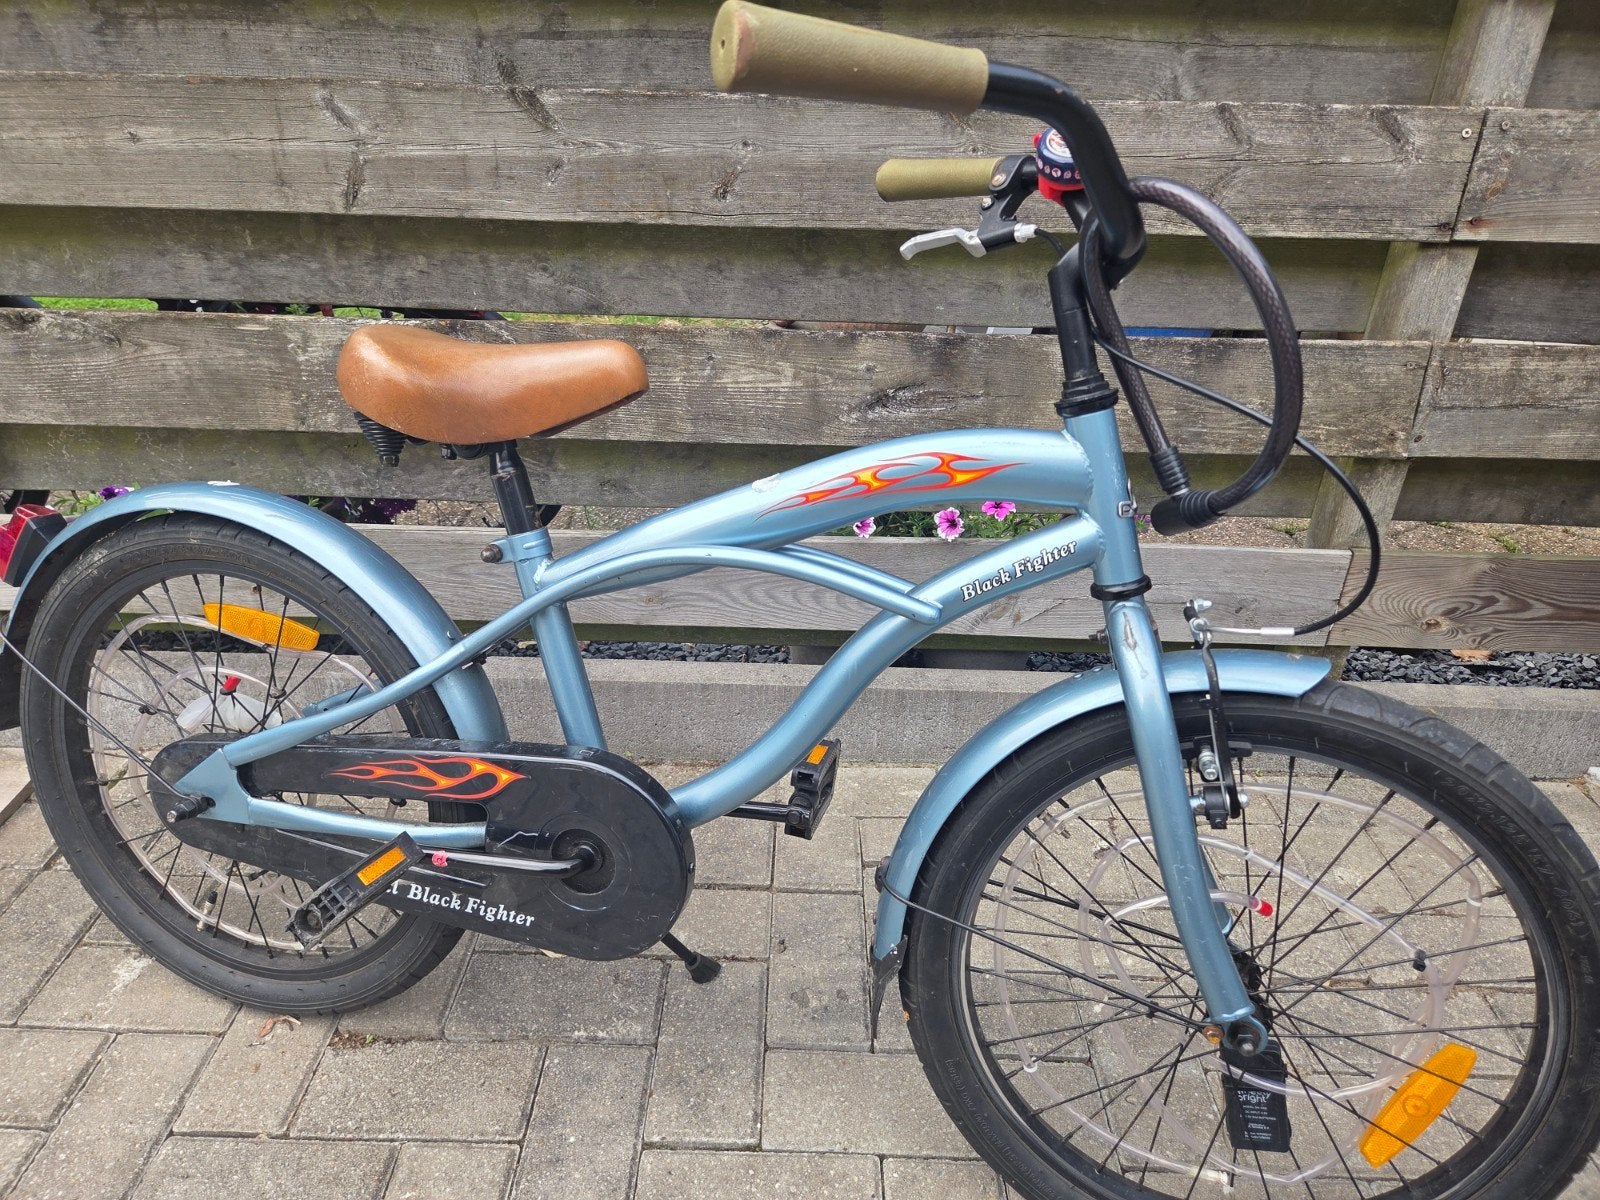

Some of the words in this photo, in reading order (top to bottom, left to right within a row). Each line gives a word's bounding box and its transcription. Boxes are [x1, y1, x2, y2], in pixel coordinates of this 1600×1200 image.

[961, 567, 1012, 601] Black
[1012, 541, 1077, 579] Fighter
[407, 883, 461, 911] Black
[465, 897, 535, 927] Fighter
